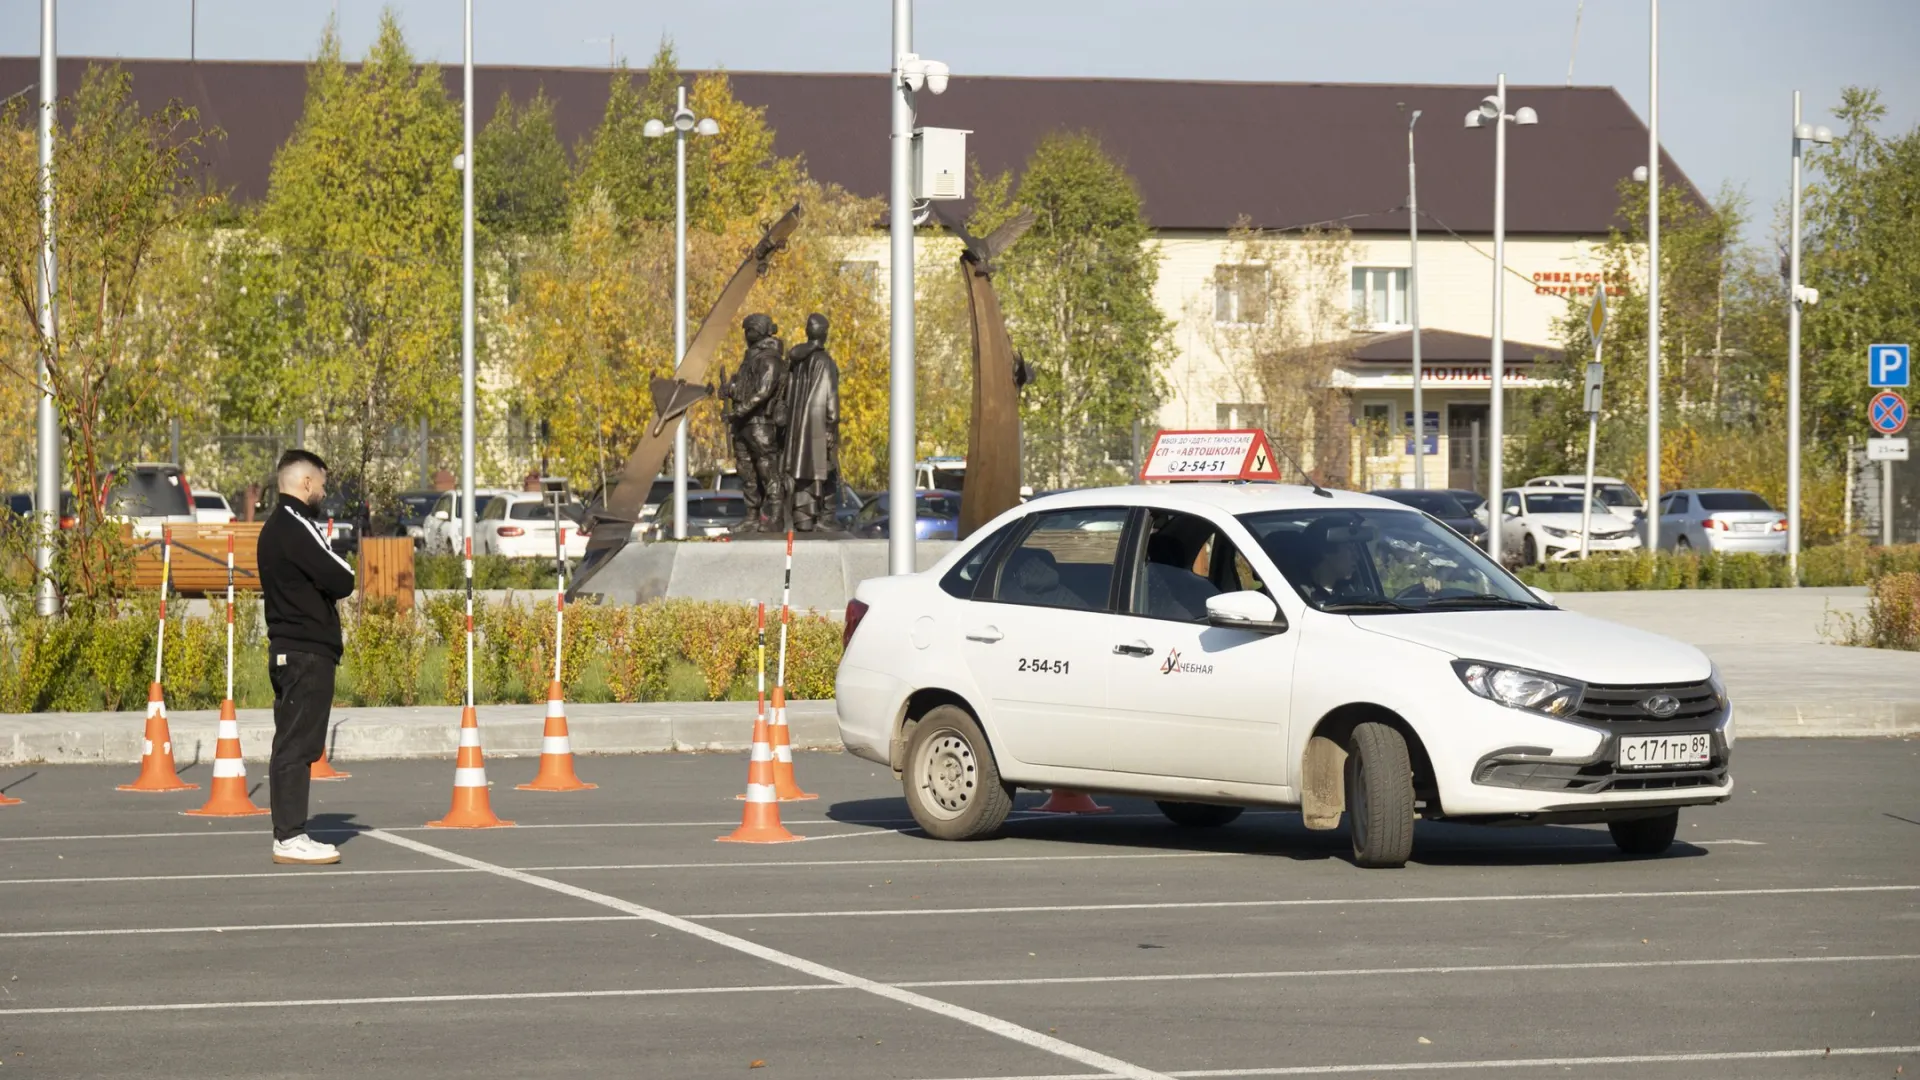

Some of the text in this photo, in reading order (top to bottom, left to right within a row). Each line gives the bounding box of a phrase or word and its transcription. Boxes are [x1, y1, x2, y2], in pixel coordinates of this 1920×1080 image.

[1879, 348, 1903, 382] P
[1156, 448, 1169, 456] СП
[1177, 446, 1247, 456] «АВТОШКОЛА»
[1179, 460, 1226, 472] 2-54-51
[1018, 658, 1070, 674] 2-54-51
